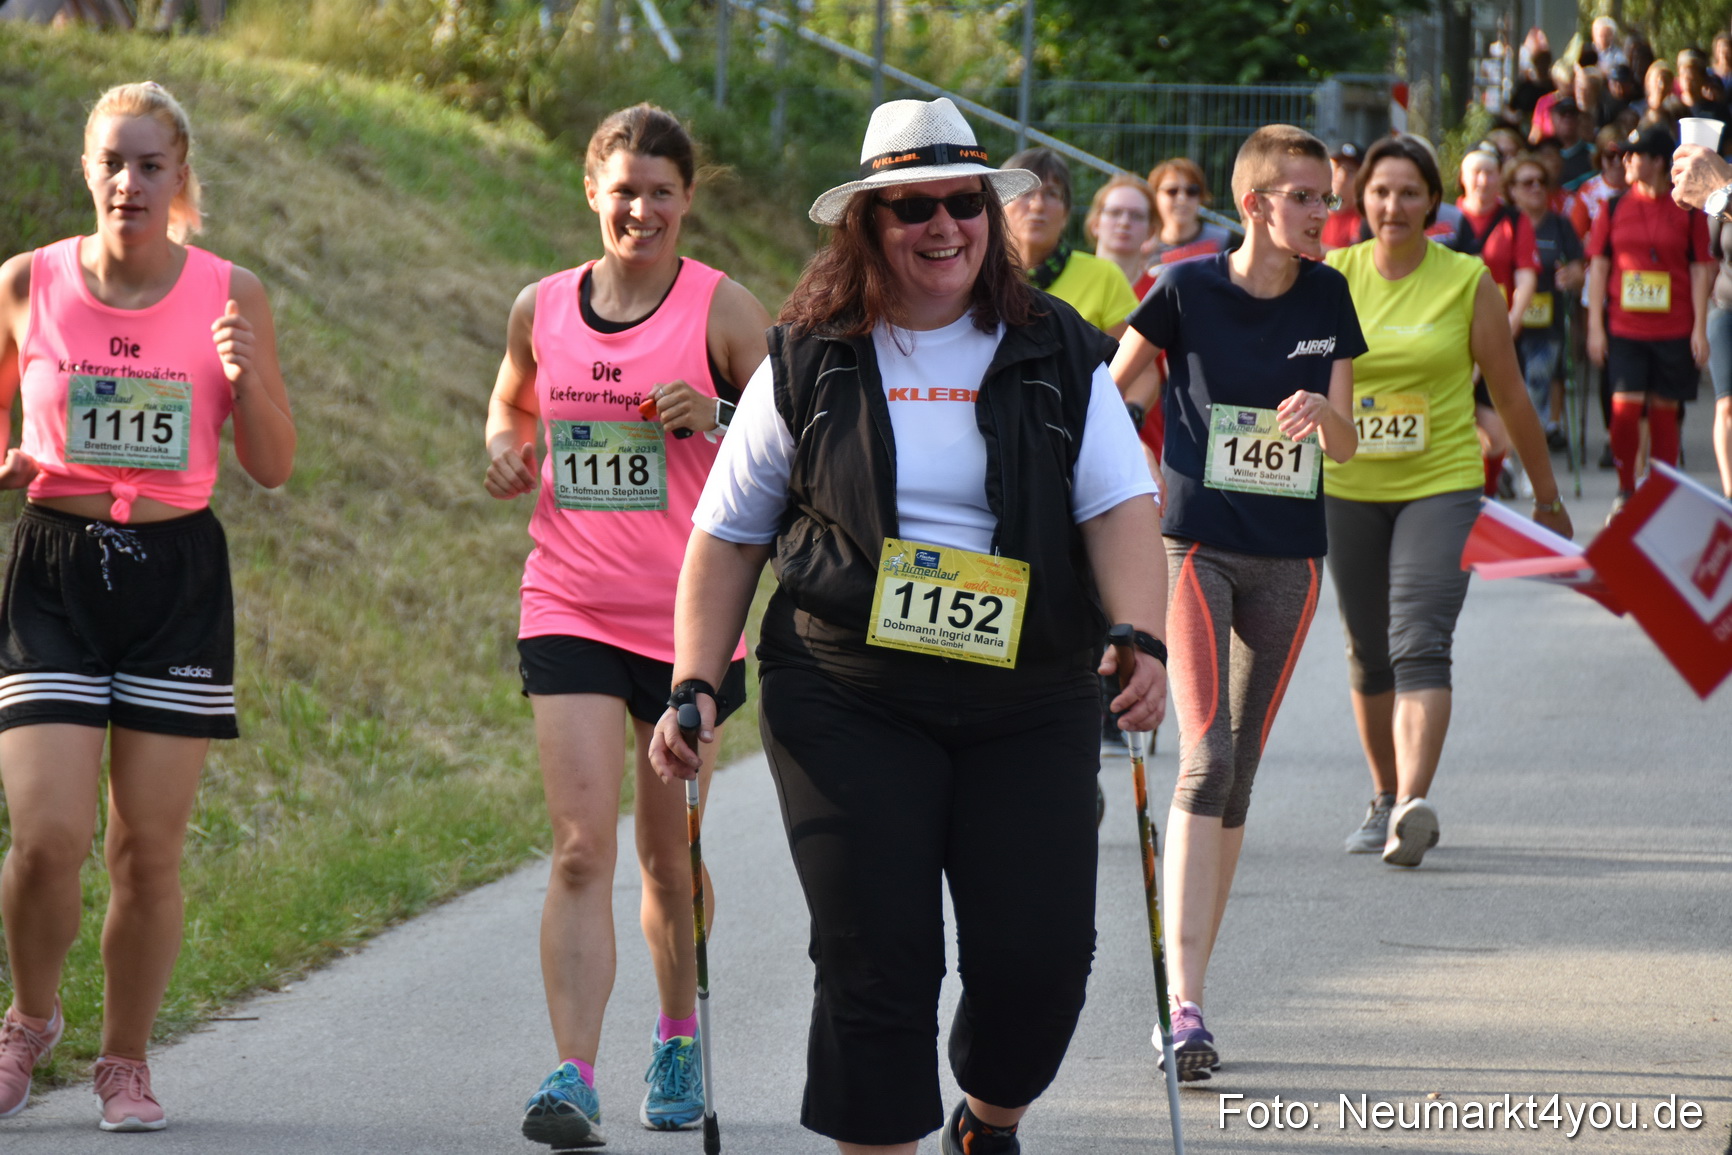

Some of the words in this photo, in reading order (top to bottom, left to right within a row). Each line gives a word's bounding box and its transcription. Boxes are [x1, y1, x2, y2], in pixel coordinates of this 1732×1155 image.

[881, 152, 920, 166] KLEBL
[110, 337, 141, 358] Die
[592, 361, 622, 383] Die
[550, 386, 643, 411] Kieferorthopä
[82, 408, 173, 444] 1115
[1356, 415, 1418, 440] 1242
[84, 441, 121, 451] Brettner
[124, 443, 169, 454] Franziska
[635, 445, 657, 453] 2019
[1224, 437, 1302, 473] 1461
[564, 453, 650, 486] 1118
[1233, 468, 1257, 478] Willer
[1259, 471, 1291, 481] Sabrina
[560, 485, 571, 493] Dr.
[572, 486, 610, 495] Hofmann
[611, 487, 658, 497] Stephanie
[901, 562, 960, 581] firmenlauf
[964, 580, 989, 592] walk
[991, 586, 1017, 597] 2019
[895, 581, 1003, 635] 1152
[883, 619, 936, 635] Dobmann
[939, 628, 971, 642] Ingrid
[974, 634, 1004, 647] Maria
[920, 636, 938, 645] Klebl
[940, 640, 963, 649] GmbH
[169, 665, 212, 678] adidas
